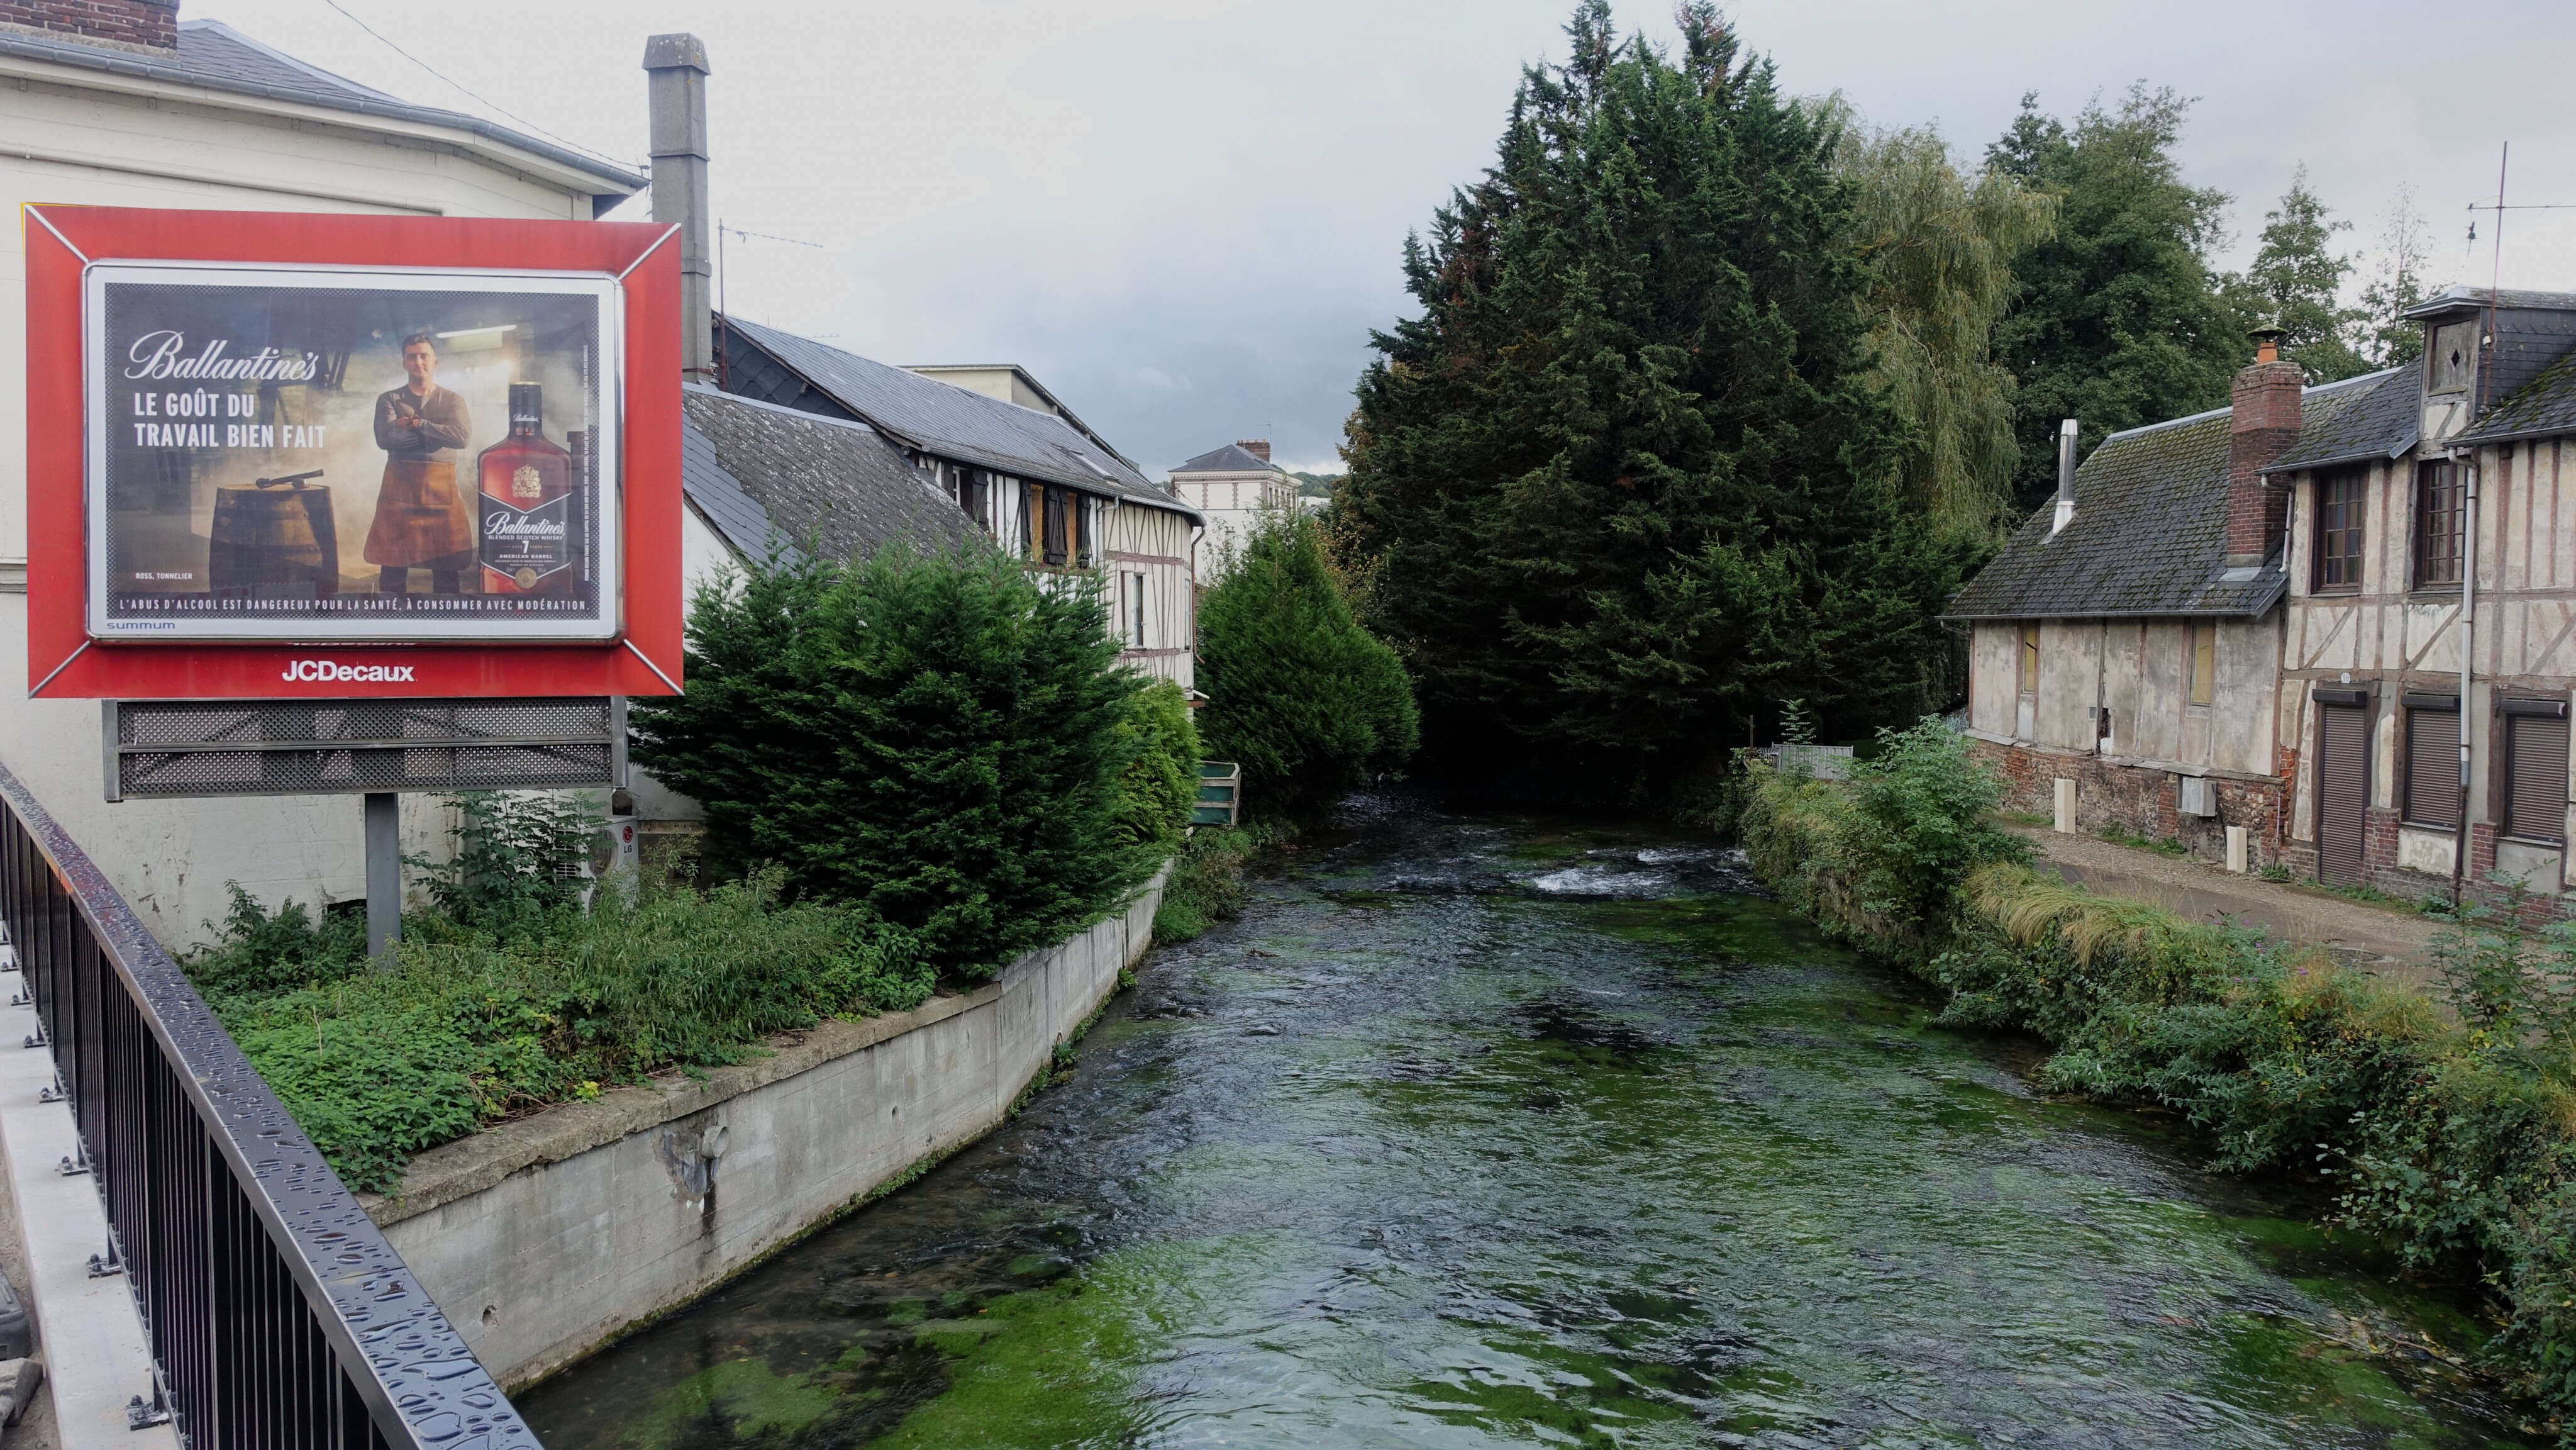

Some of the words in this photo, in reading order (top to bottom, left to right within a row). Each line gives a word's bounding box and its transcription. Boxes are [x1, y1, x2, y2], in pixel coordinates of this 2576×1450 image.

[125, 330, 319, 381] Ballantine's
[134, 393, 157, 416] LE
[166, 388, 219, 417] GOÛT
[228, 394, 254, 418] DU
[134, 423, 219, 447] TRAVAIL
[228, 424, 274, 447] BIEN
[282, 425, 326, 448] FAIT
[484, 511, 565, 535] Ballantine's
[522, 540, 530, 554] 7
[135, 572, 155, 580] ROSS,
[119, 599, 160, 610] L'ABUS
[164, 599, 218, 610] D'ALCOOL
[223, 600, 242, 610] EST
[247, 600, 310, 610] DANGEREUX
[315, 600, 343, 610] POUR
[347, 600, 359, 610] LA
[364, 598, 402, 611] SANTÉ,
[406, 598, 412, 610] À
[417, 600, 482, 610] CONSOMMER
[487, 600, 513, 610] AVEC
[518, 598, 590, 610] MODÉRATION.
[107, 622, 175, 630] summum
[282, 660, 415, 681] JCDecaux
[624, 845, 633, 853] LG
